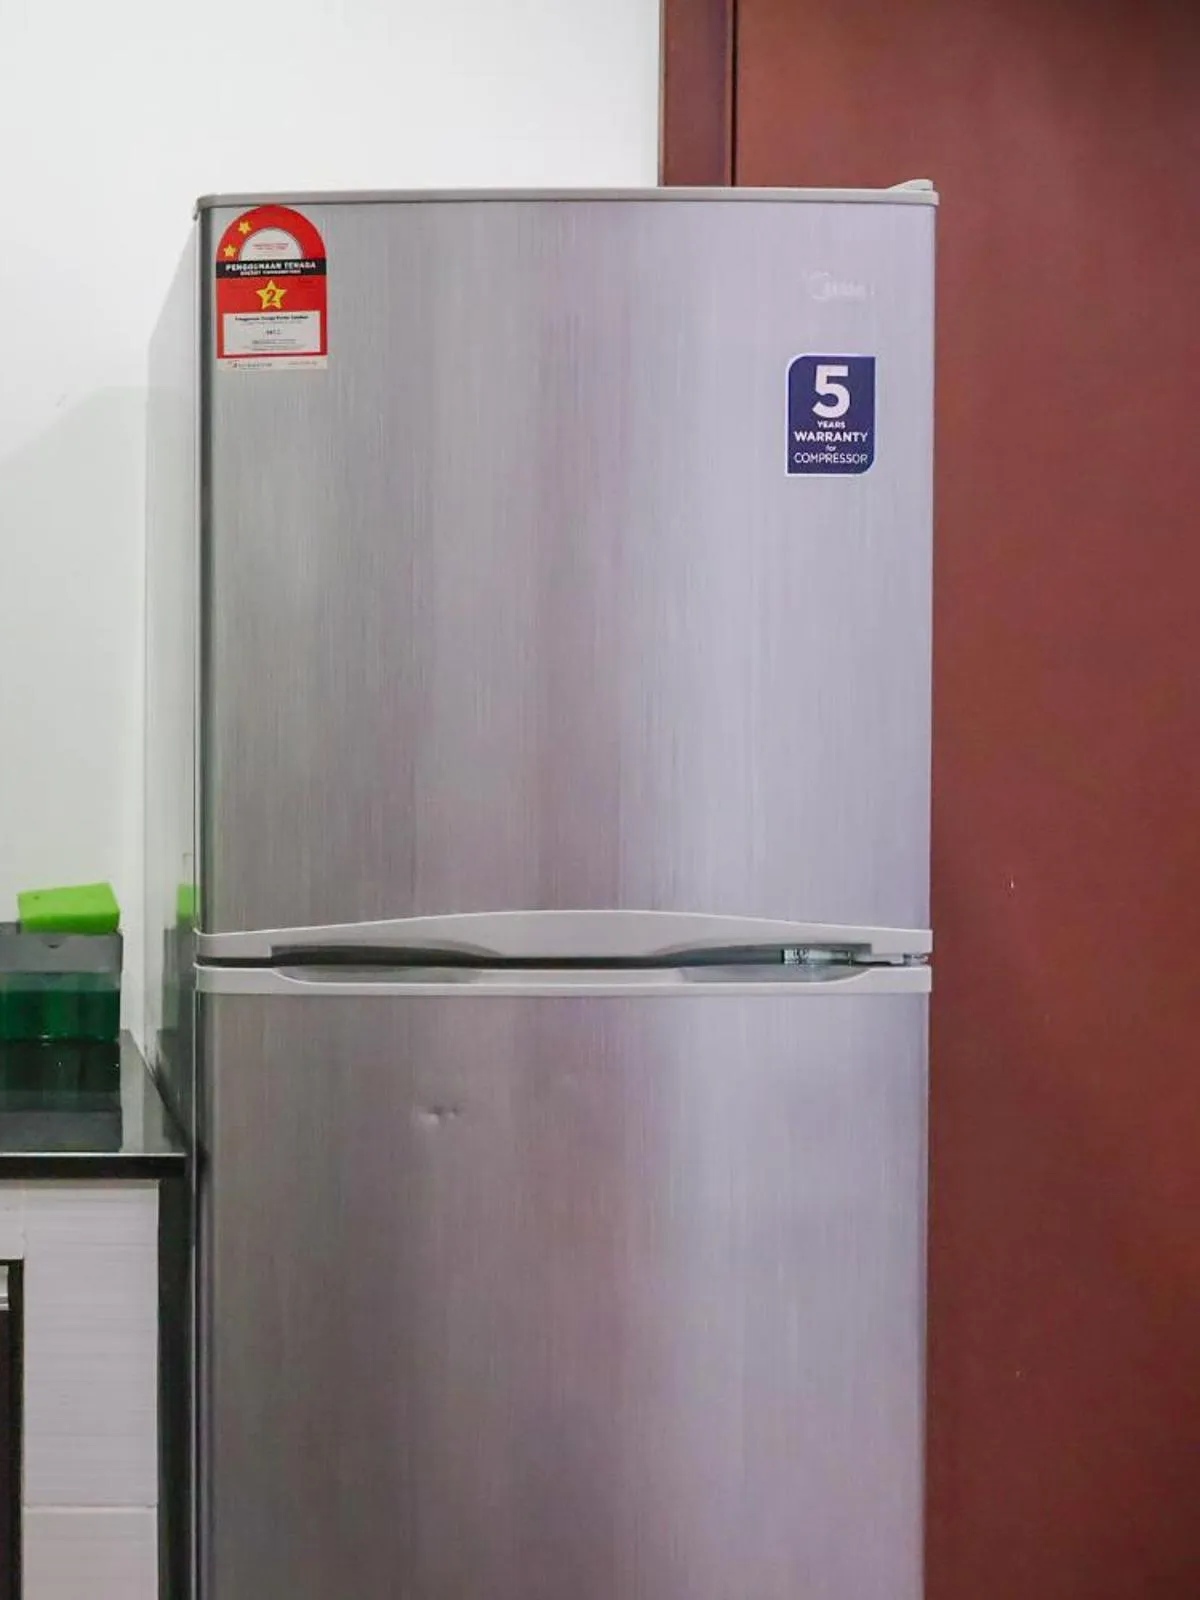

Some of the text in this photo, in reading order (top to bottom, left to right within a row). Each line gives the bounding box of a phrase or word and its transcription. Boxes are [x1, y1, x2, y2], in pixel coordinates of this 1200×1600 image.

[266, 289, 277, 303] 2
[812, 365, 850, 418] 5
[817, 420, 846, 429] YEARS
[794, 431, 868, 443] WARRANTY
[825, 444, 837, 452] for
[794, 452, 868, 464] COMPRESSOR
